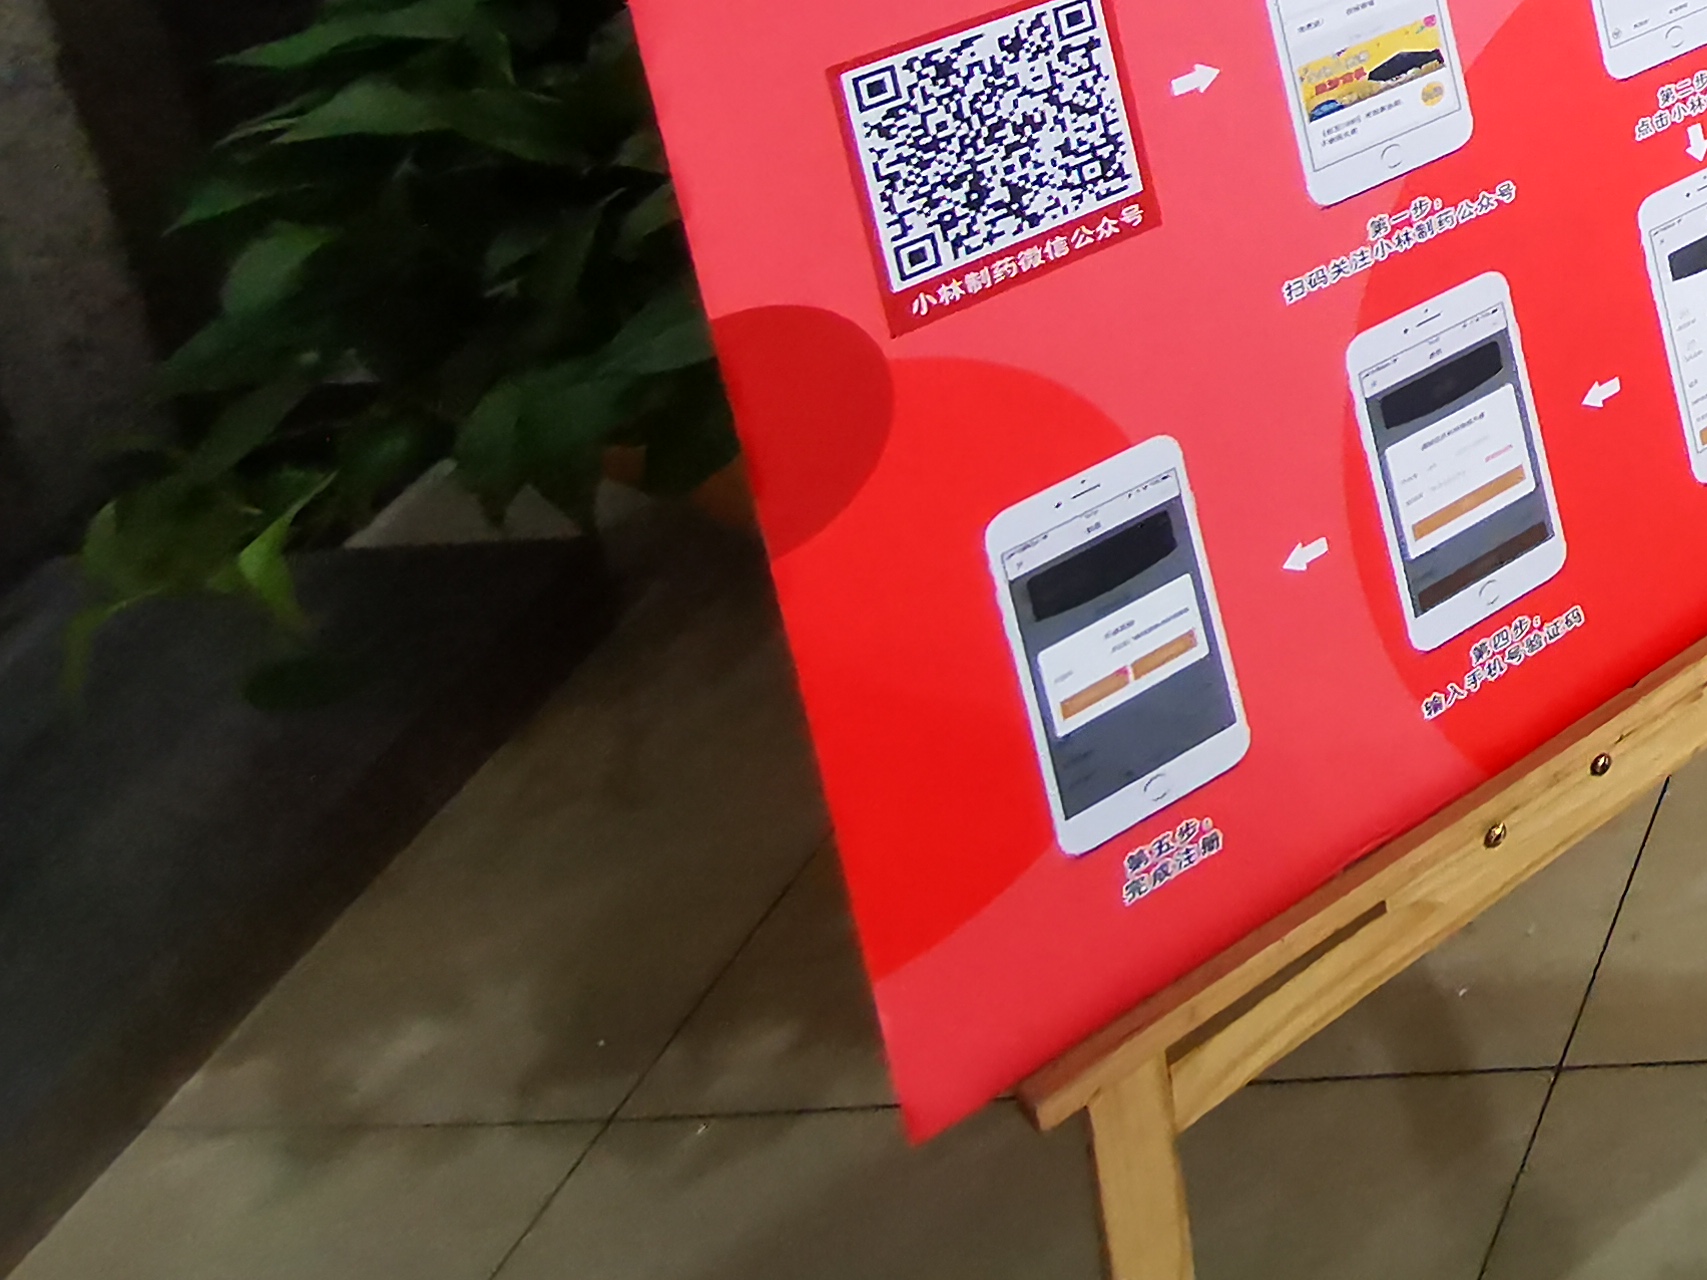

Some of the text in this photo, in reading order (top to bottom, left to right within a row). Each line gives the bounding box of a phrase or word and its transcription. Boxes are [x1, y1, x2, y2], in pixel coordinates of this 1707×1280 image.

[911, 202, 1145, 317] 小林制药微信公众号
[1284, 180, 1517, 305] 扫码关注小林制药公众号
[1422, 605, 1585, 720] 输入手机号验证码
[1123, 827, 1223, 906] 完成注册
